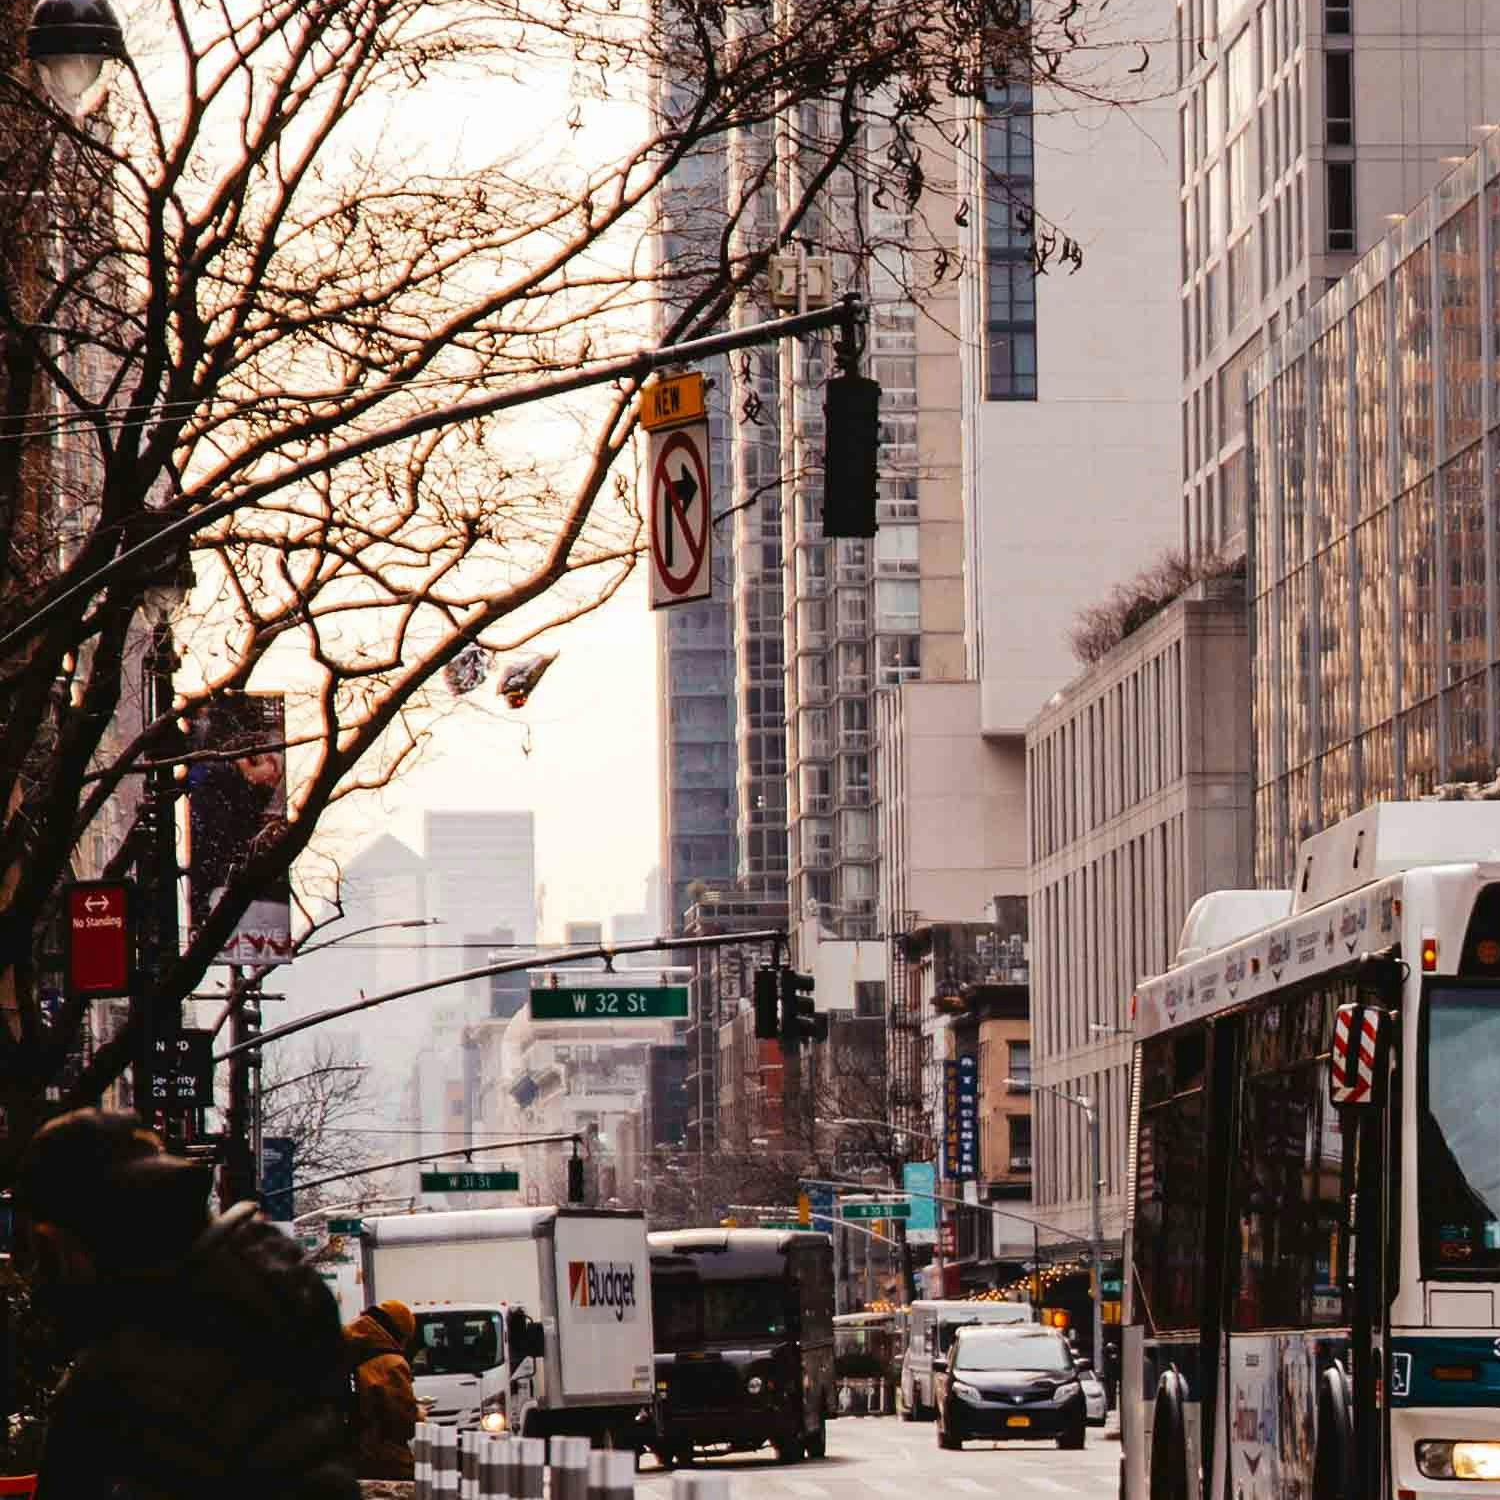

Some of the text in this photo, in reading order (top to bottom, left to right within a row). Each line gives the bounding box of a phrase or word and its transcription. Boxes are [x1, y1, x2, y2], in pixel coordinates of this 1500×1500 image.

[656, 385, 680, 418] NEW
[72, 915, 122, 929] No Standing
[572, 994, 647, 1013] W 32 St
[449, 1174, 492, 1188] W 31 St
[587, 1260, 636, 1322] Budget
